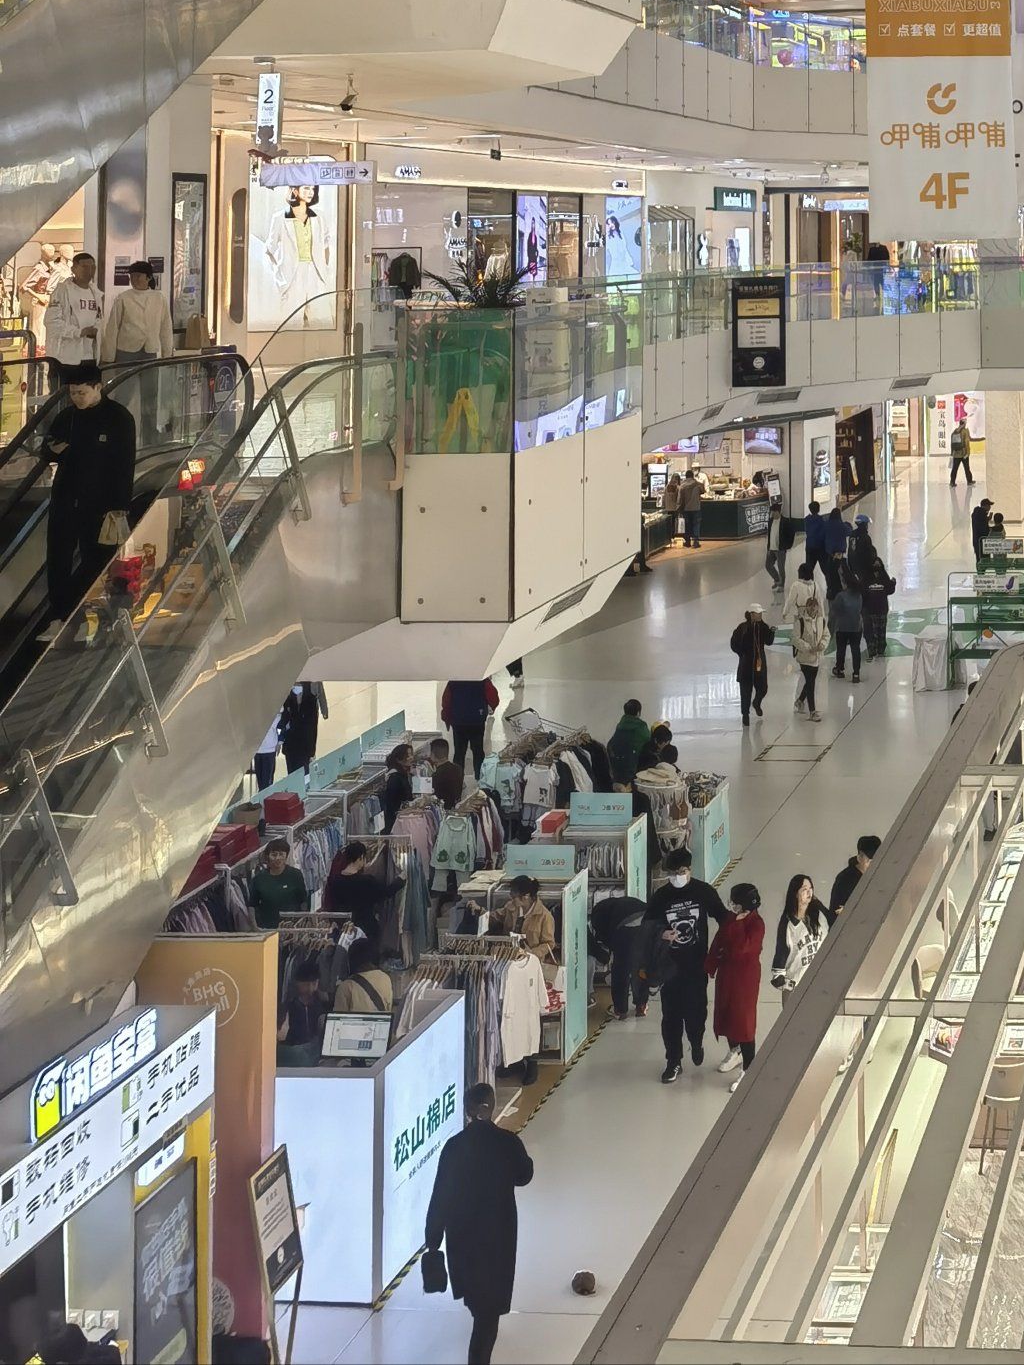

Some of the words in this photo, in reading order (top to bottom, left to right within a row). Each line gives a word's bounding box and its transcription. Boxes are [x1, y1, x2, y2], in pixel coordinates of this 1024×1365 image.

[897, 23, 936, 37] 点套餐
[962, 23, 1002, 37] 更超值
[263, 88, 274, 104] 2
[880, 120, 1006, 150] 呷哺呷哺
[919, 171, 970, 210] 4F
[192, 981, 226, 1002] BHG
[147, 1031, 200, 1090] 手机贴膜
[146, 1065, 199, 1125] 二手优品
[394, 1083, 456, 1172] 松山棉店
[25, 1155, 91, 1225] 手机维修
